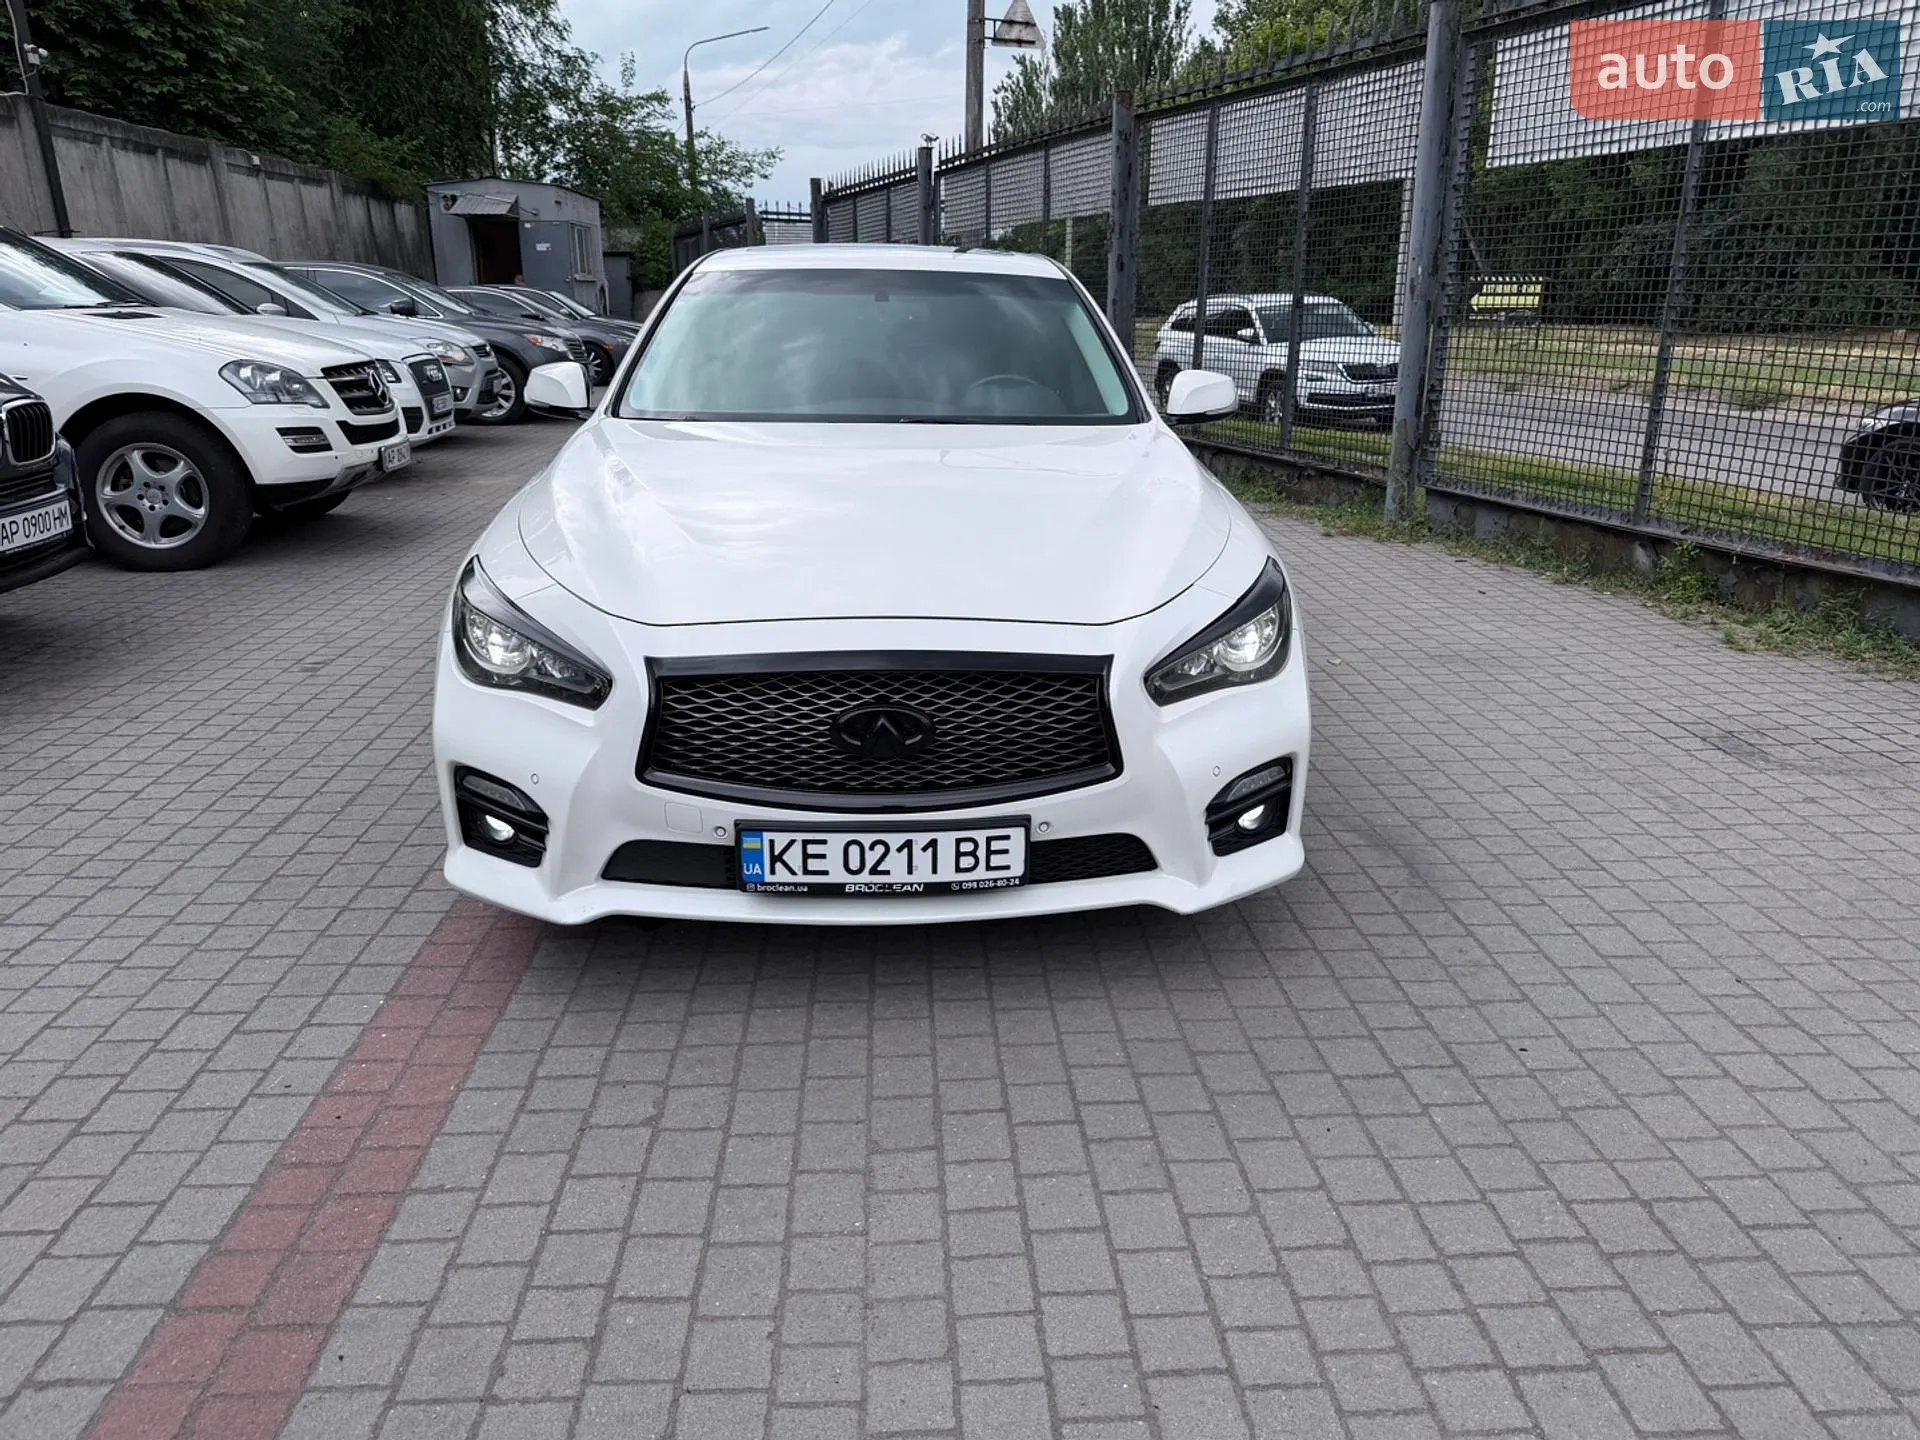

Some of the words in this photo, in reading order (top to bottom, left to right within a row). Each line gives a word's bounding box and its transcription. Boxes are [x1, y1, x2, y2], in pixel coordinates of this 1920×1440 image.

[1, 520, 20, 547] AP
[22, 510, 52, 539] 0900
[52, 504, 69, 531] HM
[768, 838, 830, 876] KE
[842, 838, 938, 876] 0211
[954, 834, 1012, 873] BE
[743, 864, 762, 875] UA
[756, 883, 809, 892] broclean.ua
